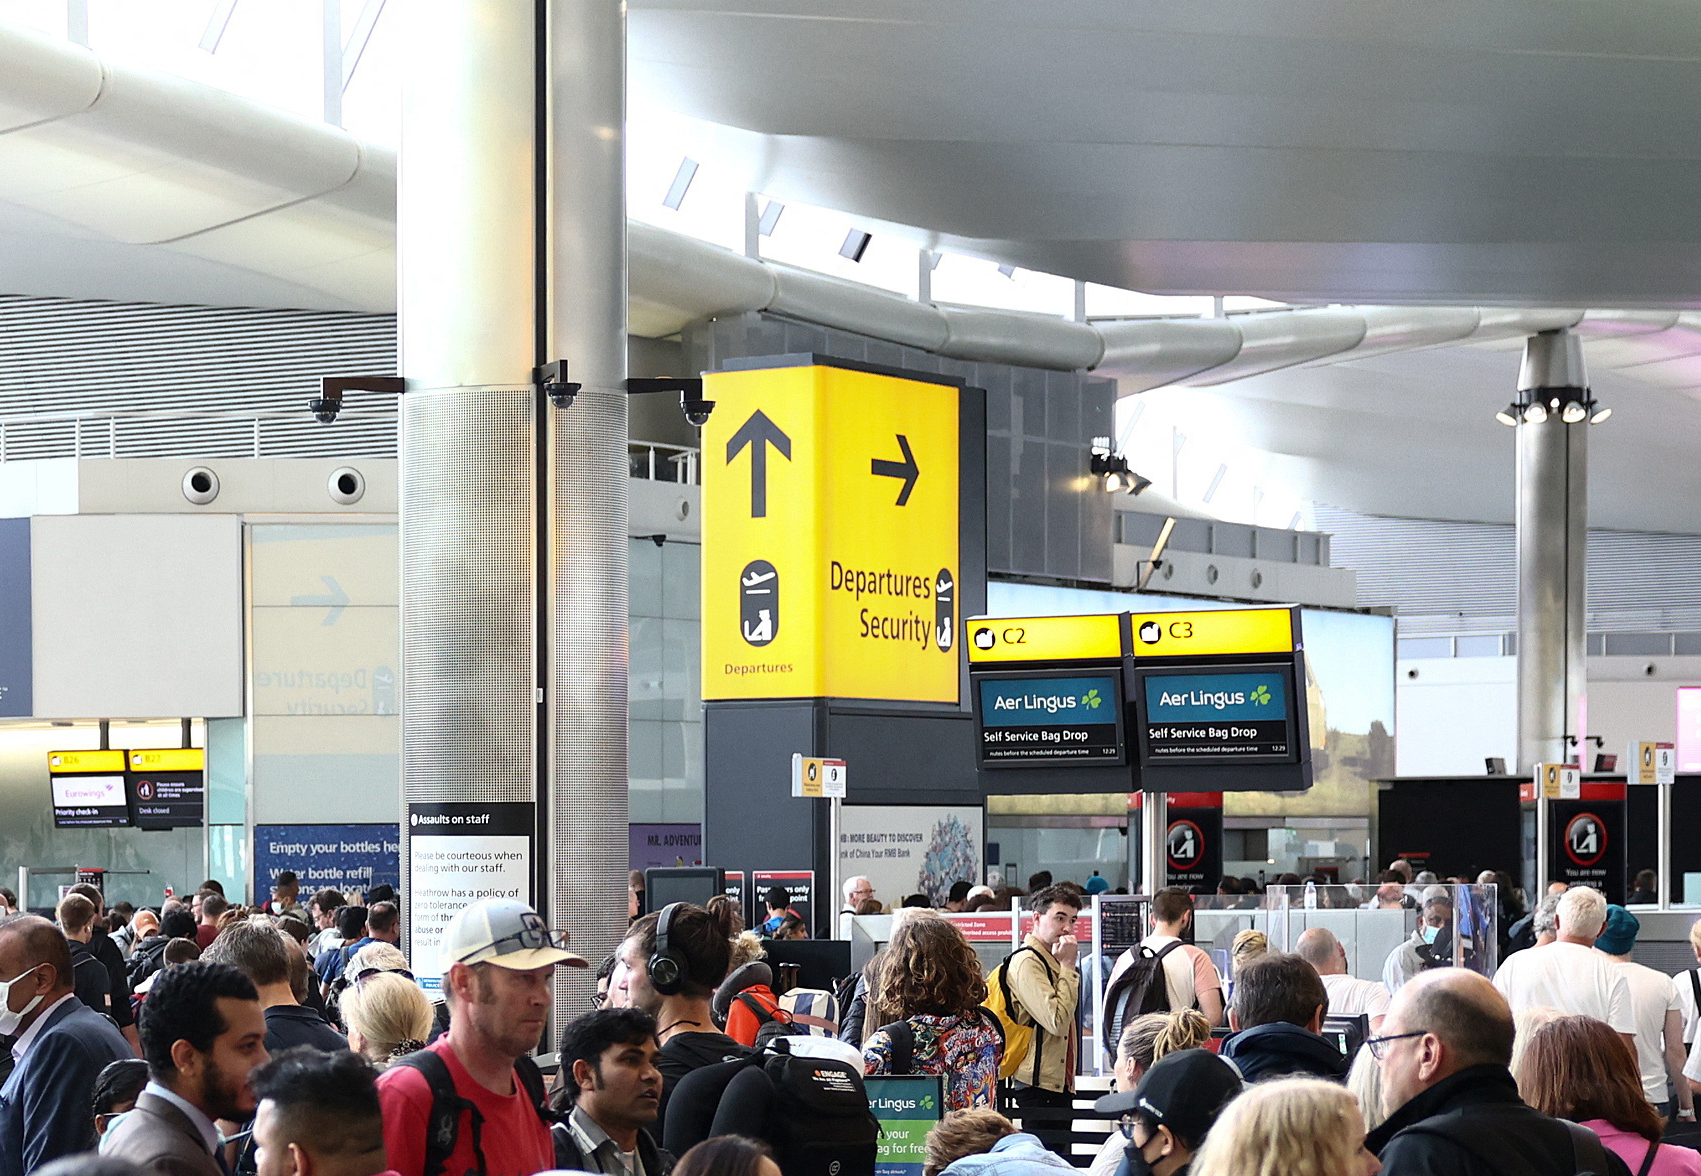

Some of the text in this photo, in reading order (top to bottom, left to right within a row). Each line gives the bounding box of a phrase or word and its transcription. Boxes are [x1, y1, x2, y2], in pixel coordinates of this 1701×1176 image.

[831, 561, 931, 600] Departures
[860, 608, 931, 650] Security
[1169, 622, 1193, 639] C3
[1002, 628, 1027, 644] C2
[724, 663, 793, 676] Departures
[994, 693, 1076, 713] Aer Lingus
[1159, 690, 1245, 709] Aer Lingus
[984, 730, 1089, 743] Self Service Bag Drop
[1149, 726, 1258, 740] Self Service Bag Drop
[65, 789, 105, 799] Eurowings
[55, 809, 75, 817] Priority
[418, 814, 490, 825] Assaults on staff
[647, 833, 701, 846] MR. ADVENTU
[850, 833, 923, 843] MORE BEAUTY TO DISCOVER
[269, 840, 399, 856] Empty your bottles he
[414, 851, 523, 860] Please be courteous when
[269, 866, 373, 879] Wer bottle refill
[414, 863, 506, 874] dealing with our staff.
[340, 882, 372, 895] locat
[414, 888, 450, 897] Heathrow
[451, 888, 466, 897] has
[476, 888, 505, 899] policy
[508, 888, 519, 897] of
[725, 886, 740, 895] only
[794, 885, 810, 895] only
[789, 894, 808, 904] point
[429, 901, 468, 909] tolerance
[430, 913, 439, 921] of
[414, 925, 434, 934] abuse
[433, 938, 441, 947] in
[878, 1097, 916, 1112] Lingus
[886, 1130, 910, 1141] your
[877, 1145, 890, 1155] ag
[892, 1143, 907, 1154] for
